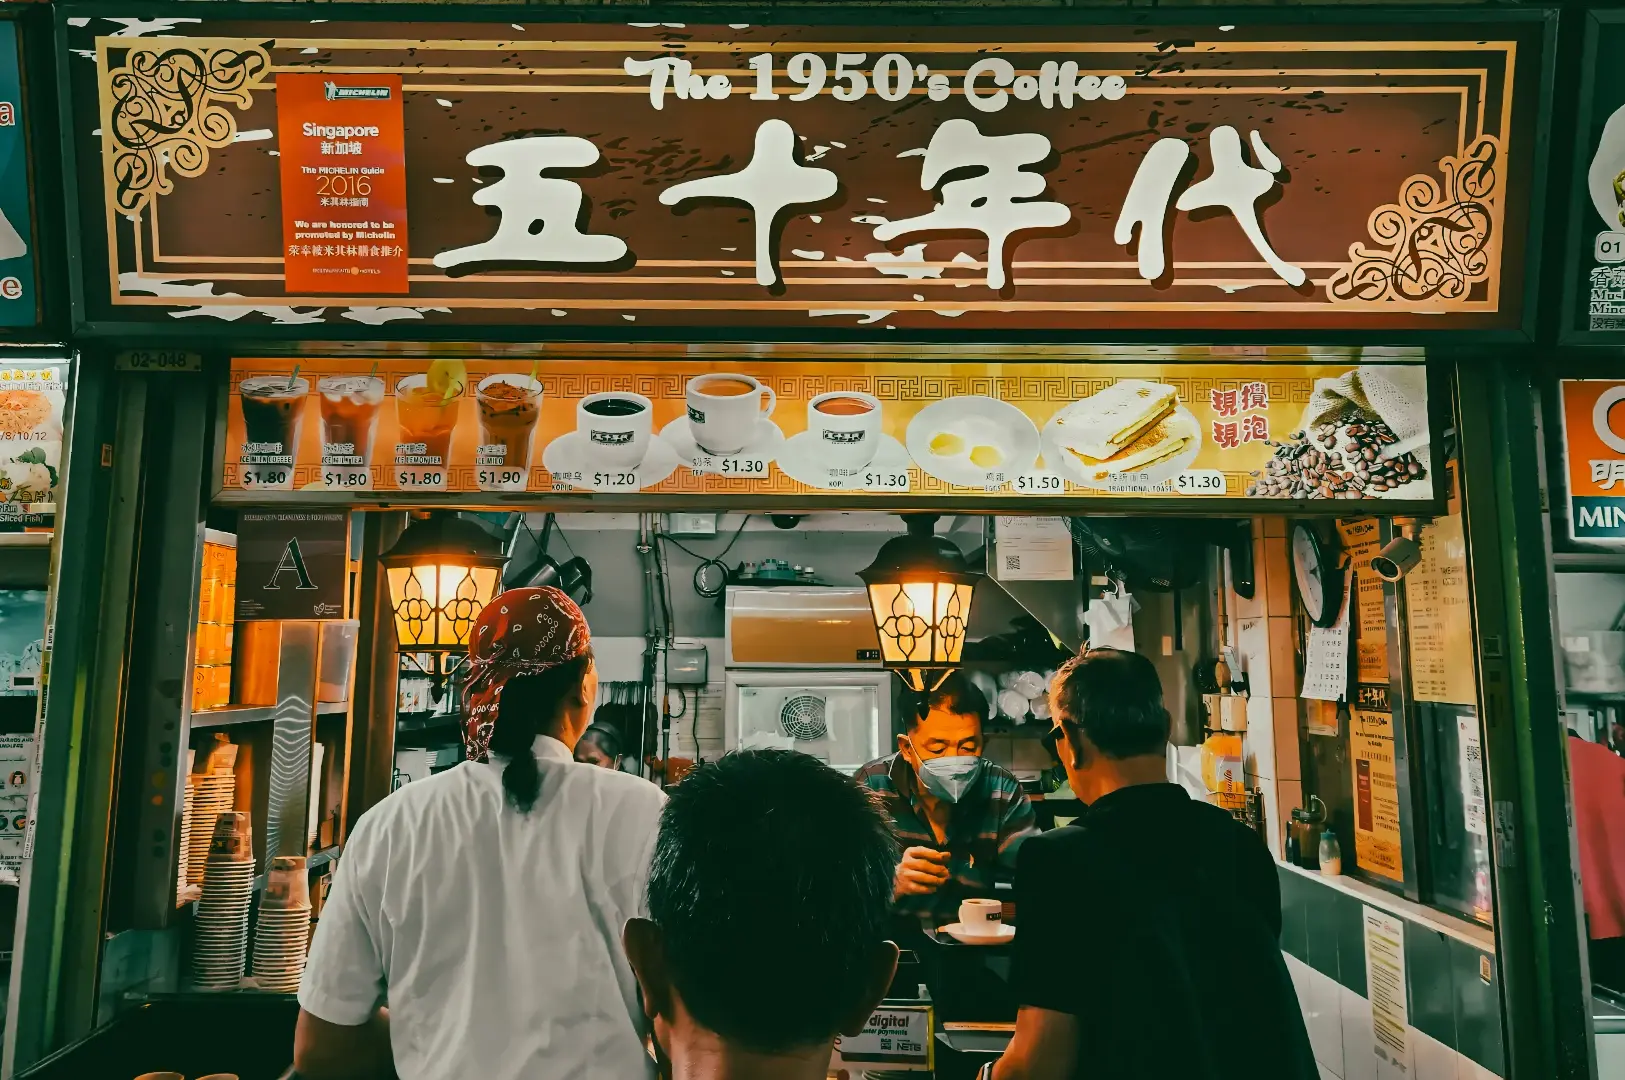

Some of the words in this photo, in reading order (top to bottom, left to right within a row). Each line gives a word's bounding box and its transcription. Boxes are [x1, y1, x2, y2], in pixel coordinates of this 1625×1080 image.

[624, 56, 732, 110] The
[749, 53, 951, 102] 1950's
[963, 57, 1127, 113] Coffee
[337, 89, 389, 97] MICHELIN
[302, 122, 379, 139] Singapore
[320, 141, 362, 155] 新加坡
[301, 166, 316, 174] The
[318, 166, 359, 175] MICHELIN
[360, 166, 385, 175] Guide
[316, 175, 372, 196] 2016
[433, 118, 1306, 289] 五十年代
[294, 220, 309, 229] We
[311, 221, 328, 229] are
[329, 221, 369, 229] honored
[370, 221, 380, 229] to
[382, 221, 395, 229] be
[295, 231, 341, 240] promoted
[341, 231, 354, 240] by
[355, 231, 396, 240] Michelin
[1600, 241, 1621, 254] 01
[130, 352, 187, 368] 02-048
[721, 459, 763, 473] $1.30
[243, 471, 286, 485] $1.80
[325, 472, 367, 486] $1.80
[399, 471, 441, 485] $1.80
[479, 470, 520, 484] $1.90
[593, 472, 635, 486] $1.20
[865, 473, 907, 487] $1.30
[1018, 476, 1060, 489] $1.50
[1178, 475, 1221, 488] $1.30
[263, 537, 318, 590] A
[869, 1014, 909, 1029] digital
[877, 1028, 908, 1036] payments
[896, 1043, 921, 1051] NETS
